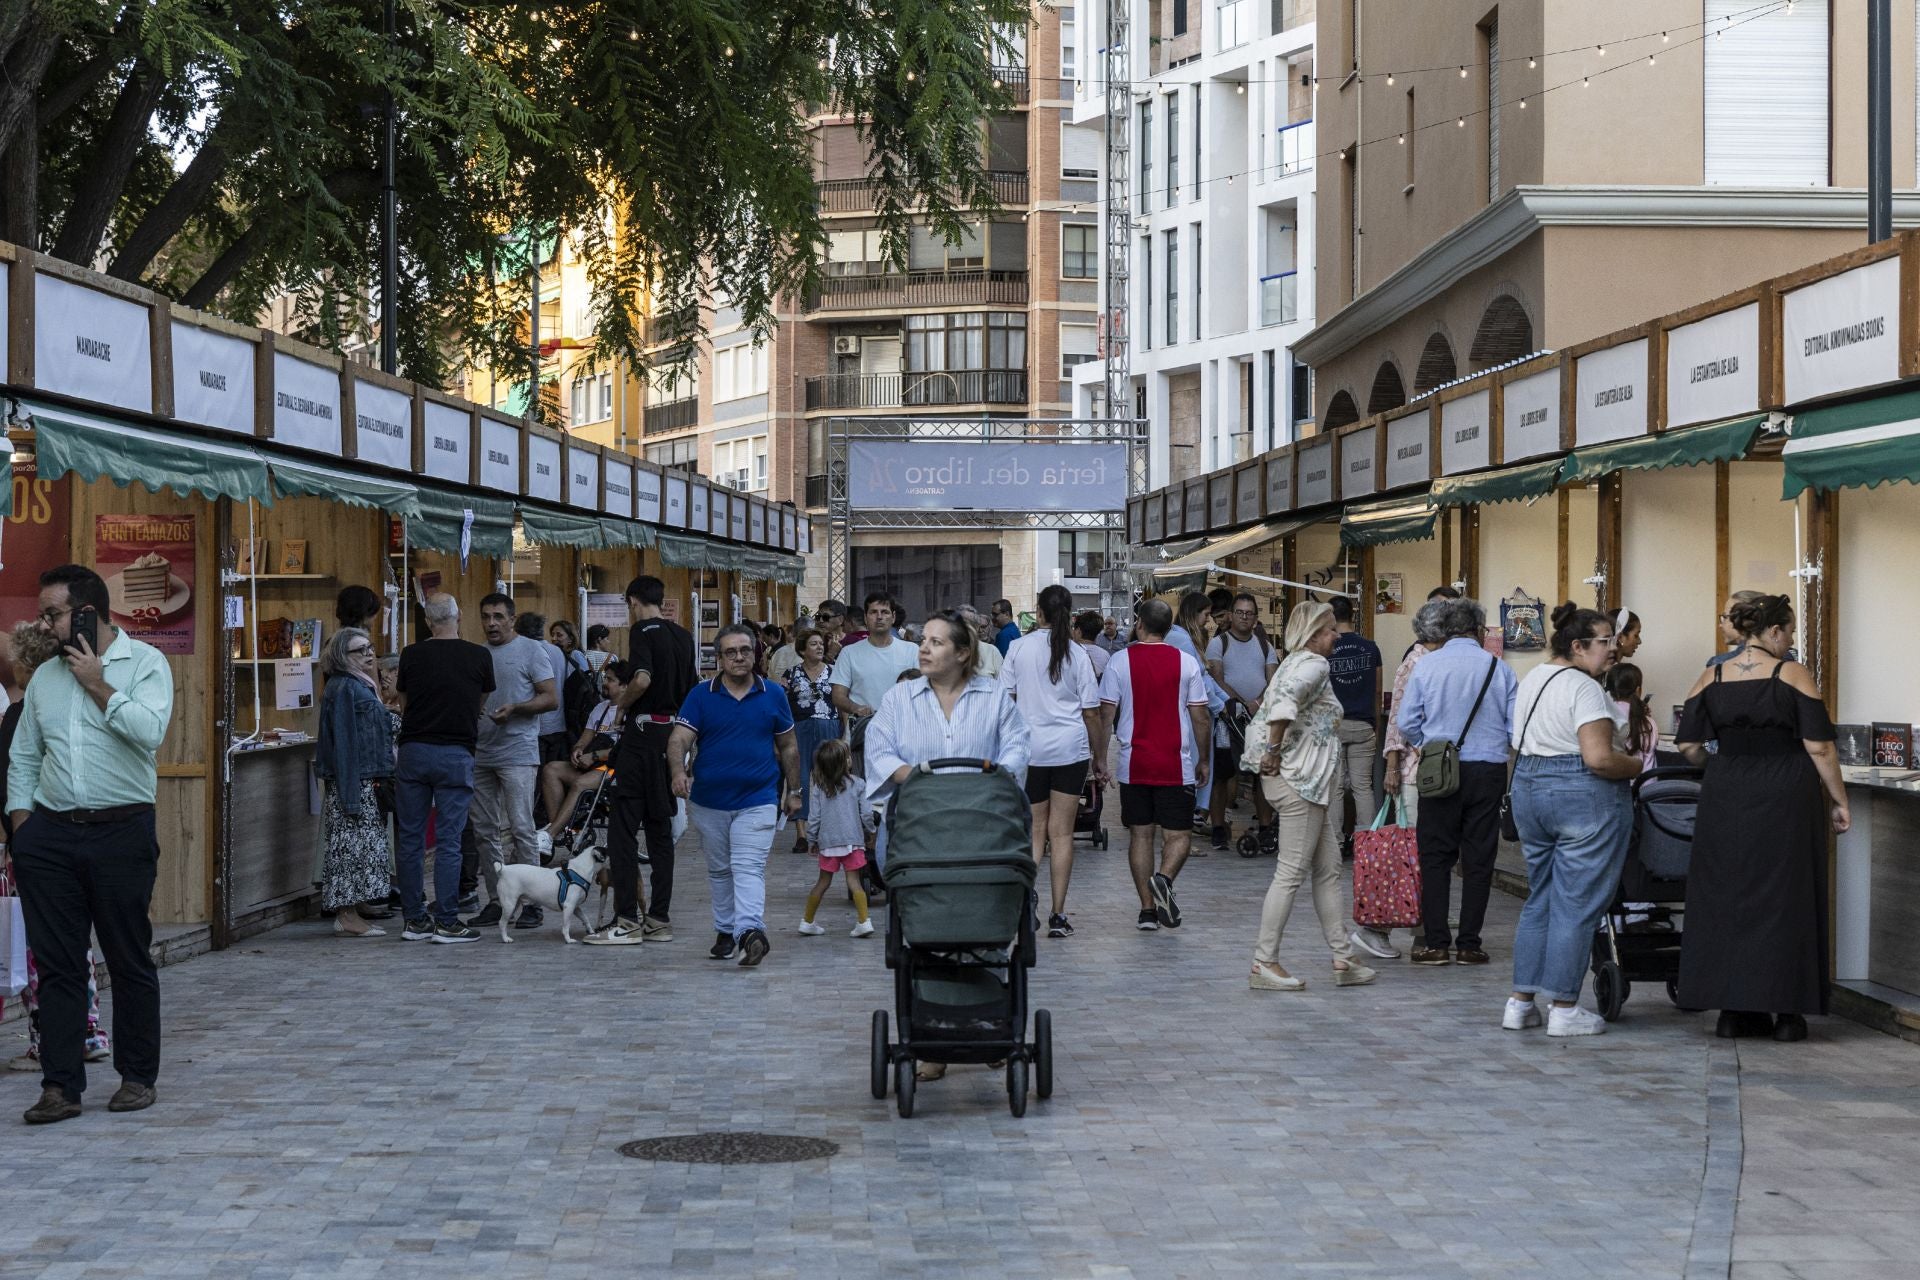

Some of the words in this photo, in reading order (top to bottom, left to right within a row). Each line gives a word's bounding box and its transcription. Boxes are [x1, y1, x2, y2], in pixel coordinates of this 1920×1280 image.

[1804, 333, 1829, 357] EDITORIAL
[1830, 322, 1865, 350] KNOWMADAS
[1866, 316, 1884, 340] BOOKS
[76, 335, 111, 362] MANDARACHE
[1690, 367, 1696, 384] LA
[1721, 358, 1727, 376] DE
[1727, 355, 1738, 374] ALBA
[200, 370, 226, 391] MANDARACHE
[132, 606, 160, 617] 20
[1875, 738, 1904, 751] FUEGO
[1875, 751, 1904, 766] CIELO
